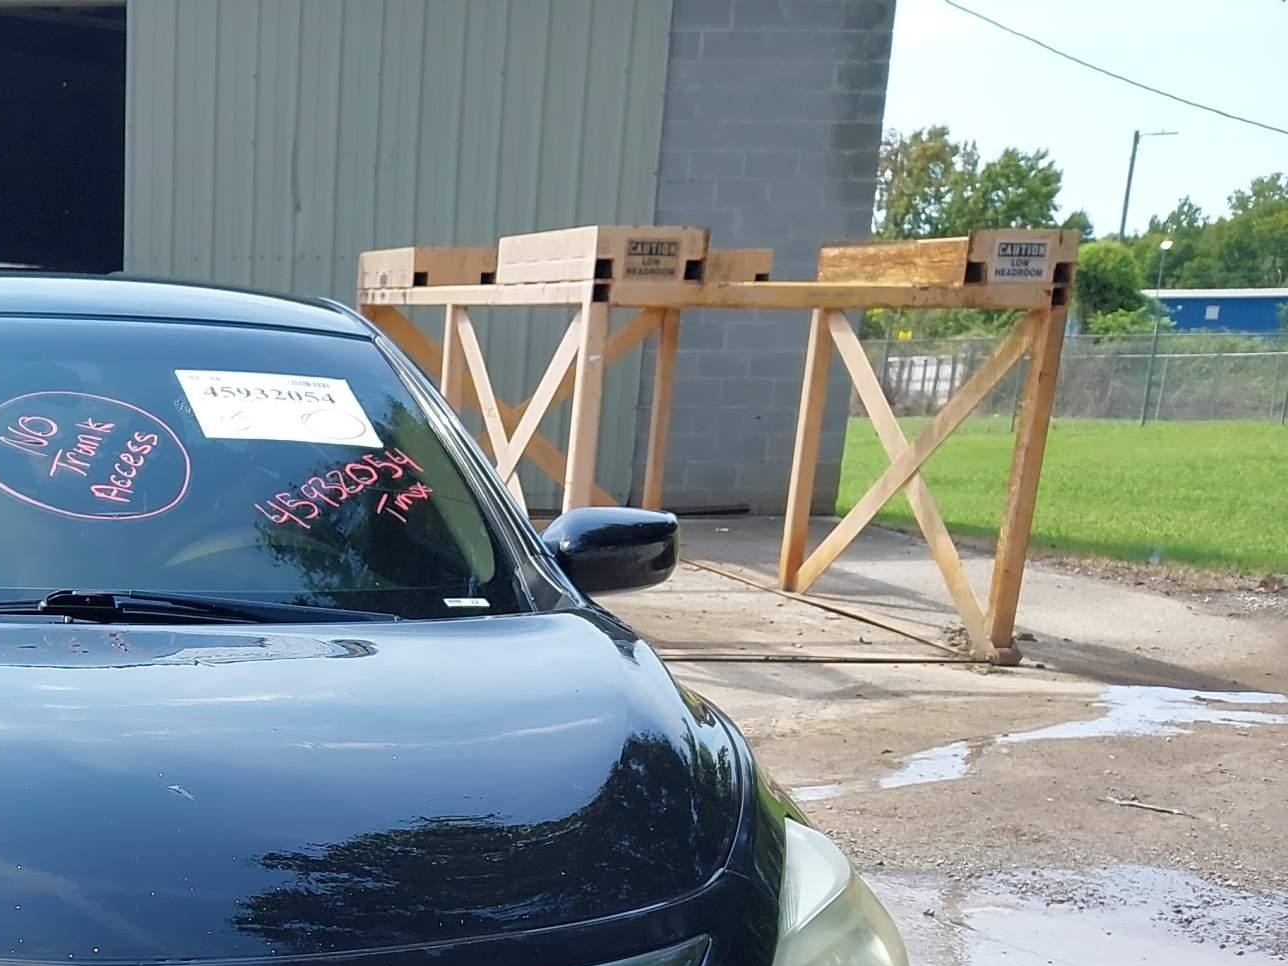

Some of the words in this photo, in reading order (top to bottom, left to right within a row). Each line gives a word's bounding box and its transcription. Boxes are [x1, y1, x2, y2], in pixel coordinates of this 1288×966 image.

[629, 242, 678, 254] CAUTION
[999, 244, 1046, 255] CAUTION
[642, 258, 660, 266] LOW
[1011, 259, 1029, 267] LOW
[995, 267, 1043, 277] HEADROOM
[203, 385, 336, 405] 45932054
[254, 447, 424, 529] 45932054
